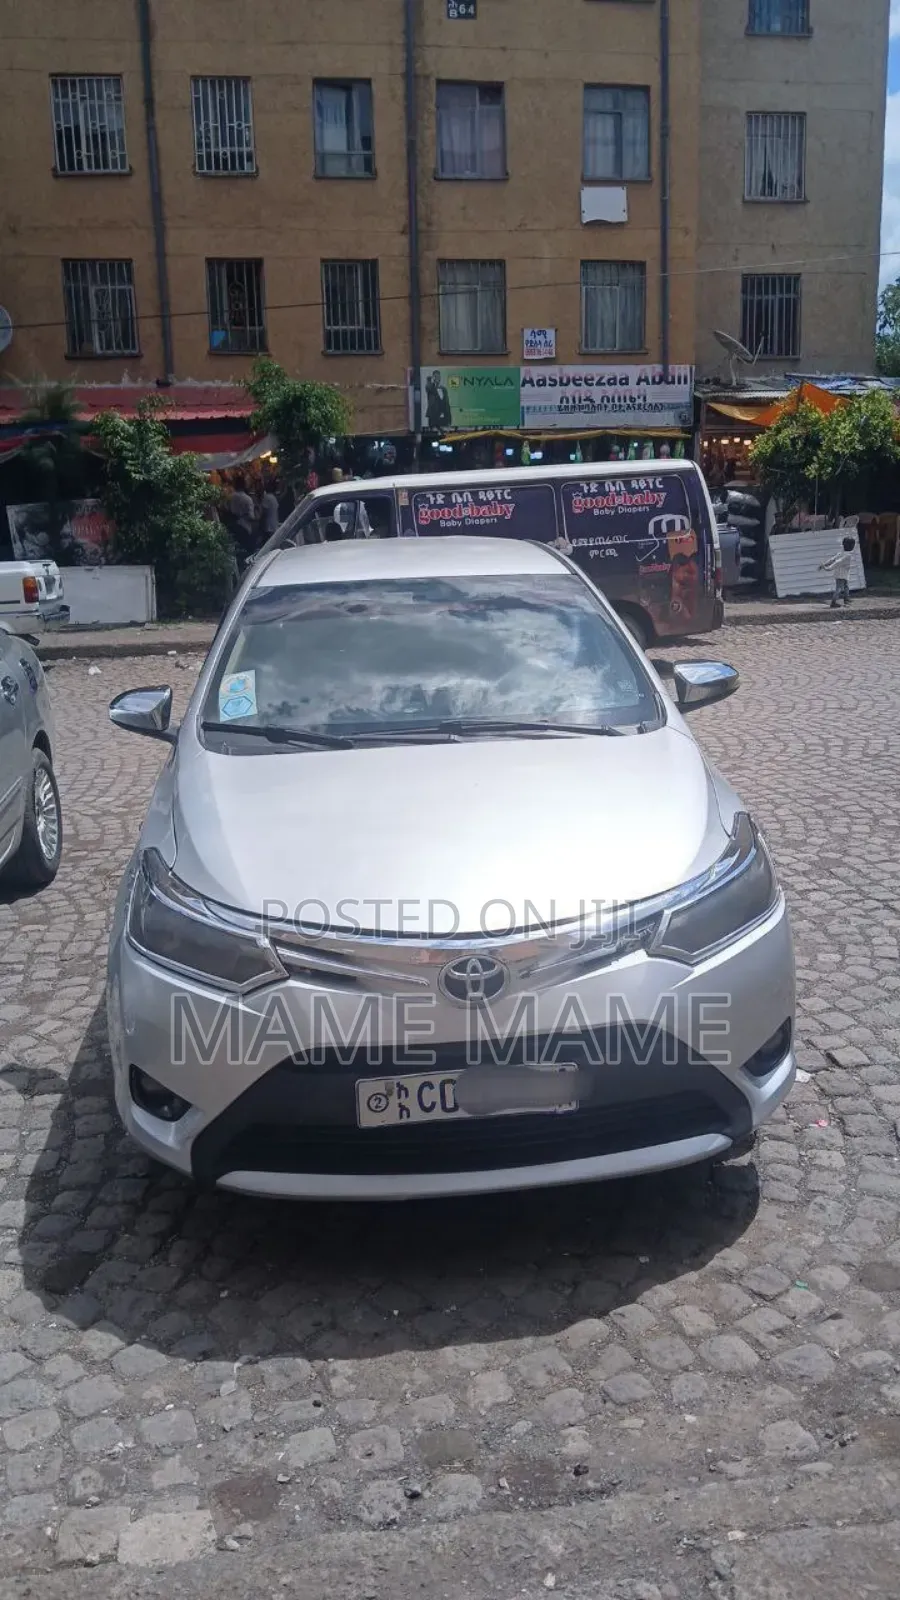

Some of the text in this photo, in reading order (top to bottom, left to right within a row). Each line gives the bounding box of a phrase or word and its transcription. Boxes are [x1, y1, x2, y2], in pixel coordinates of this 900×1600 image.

[463, 375, 514, 387] NYALA
[521, 367, 630, 388] Aasbeezaa
[593, 506, 650, 516] Baby Diapers
[440, 517, 498, 528] Baby Diapers
